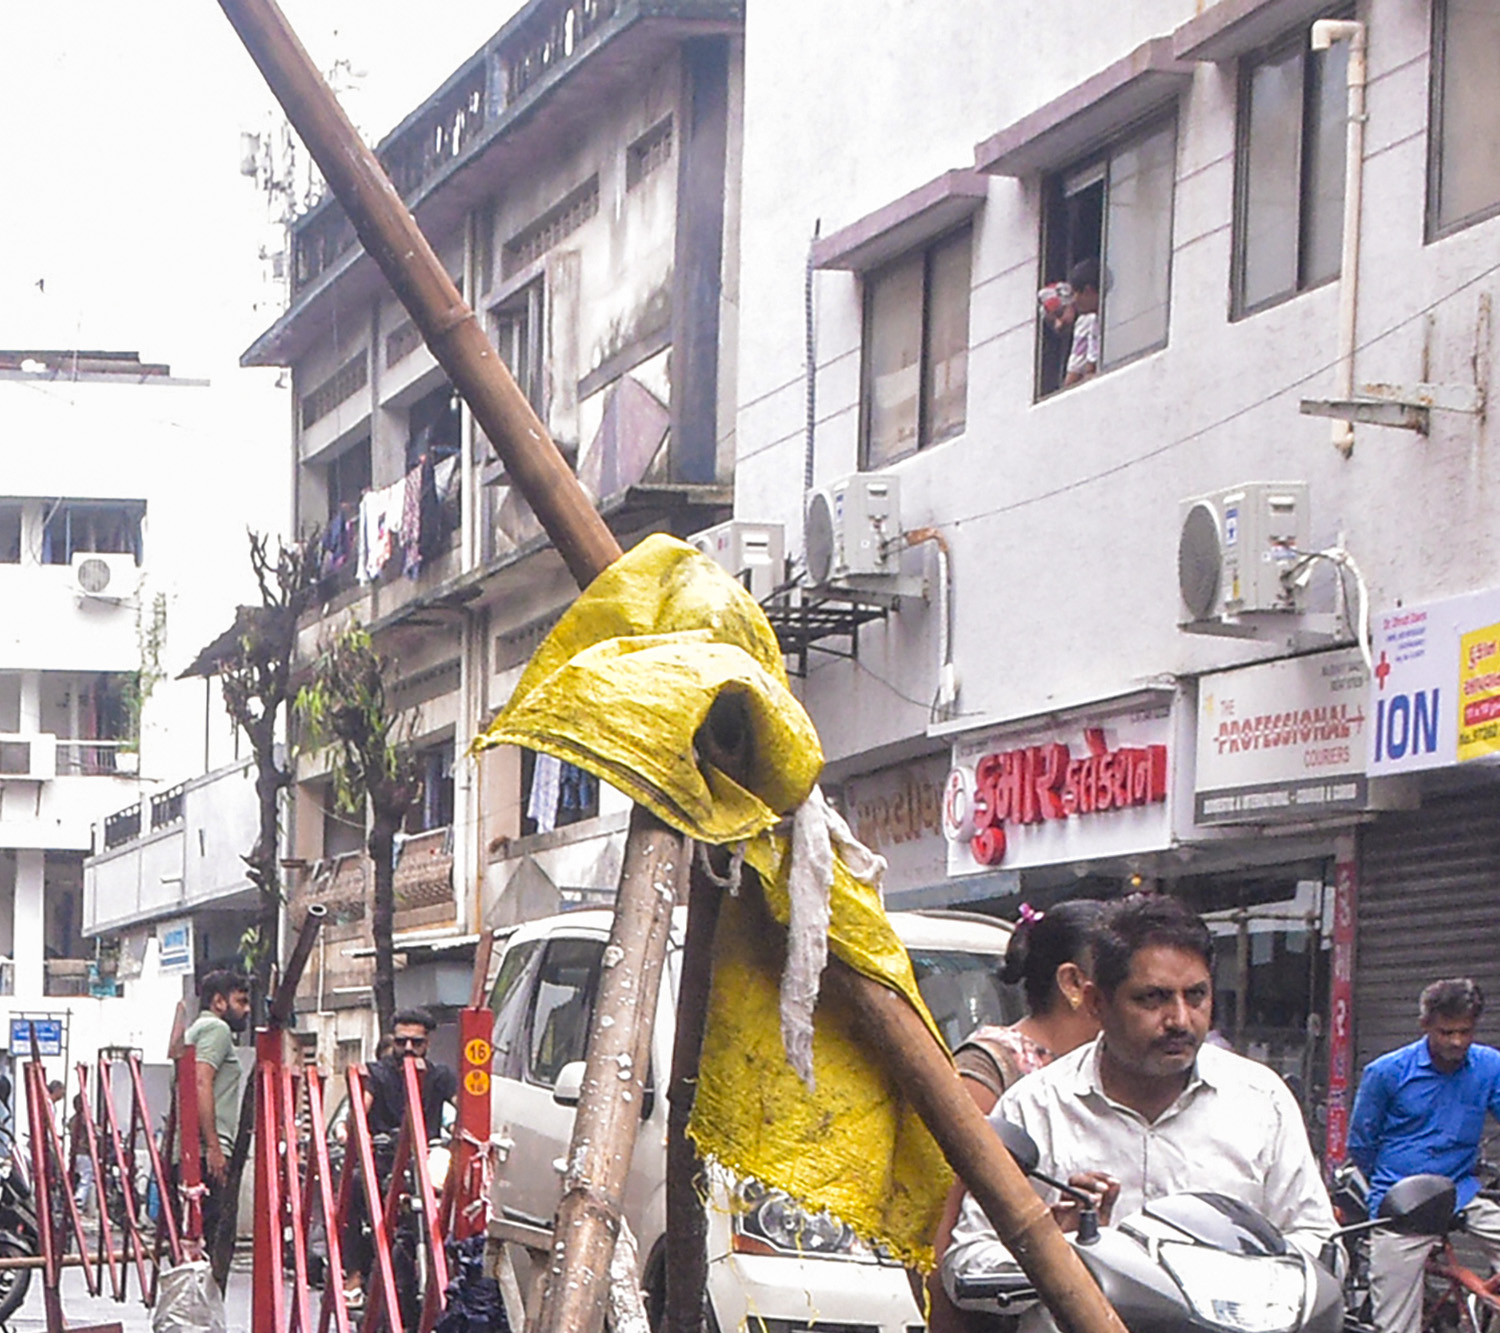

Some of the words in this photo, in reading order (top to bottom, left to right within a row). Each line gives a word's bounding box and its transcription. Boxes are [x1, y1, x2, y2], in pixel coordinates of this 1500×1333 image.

[1217, 703, 1351, 755] PROFESSIONAL
[1304, 746, 1350, 768] COURIERS
[1375, 687, 1439, 763] ION
[972, 742, 1069, 866] કુમાર
